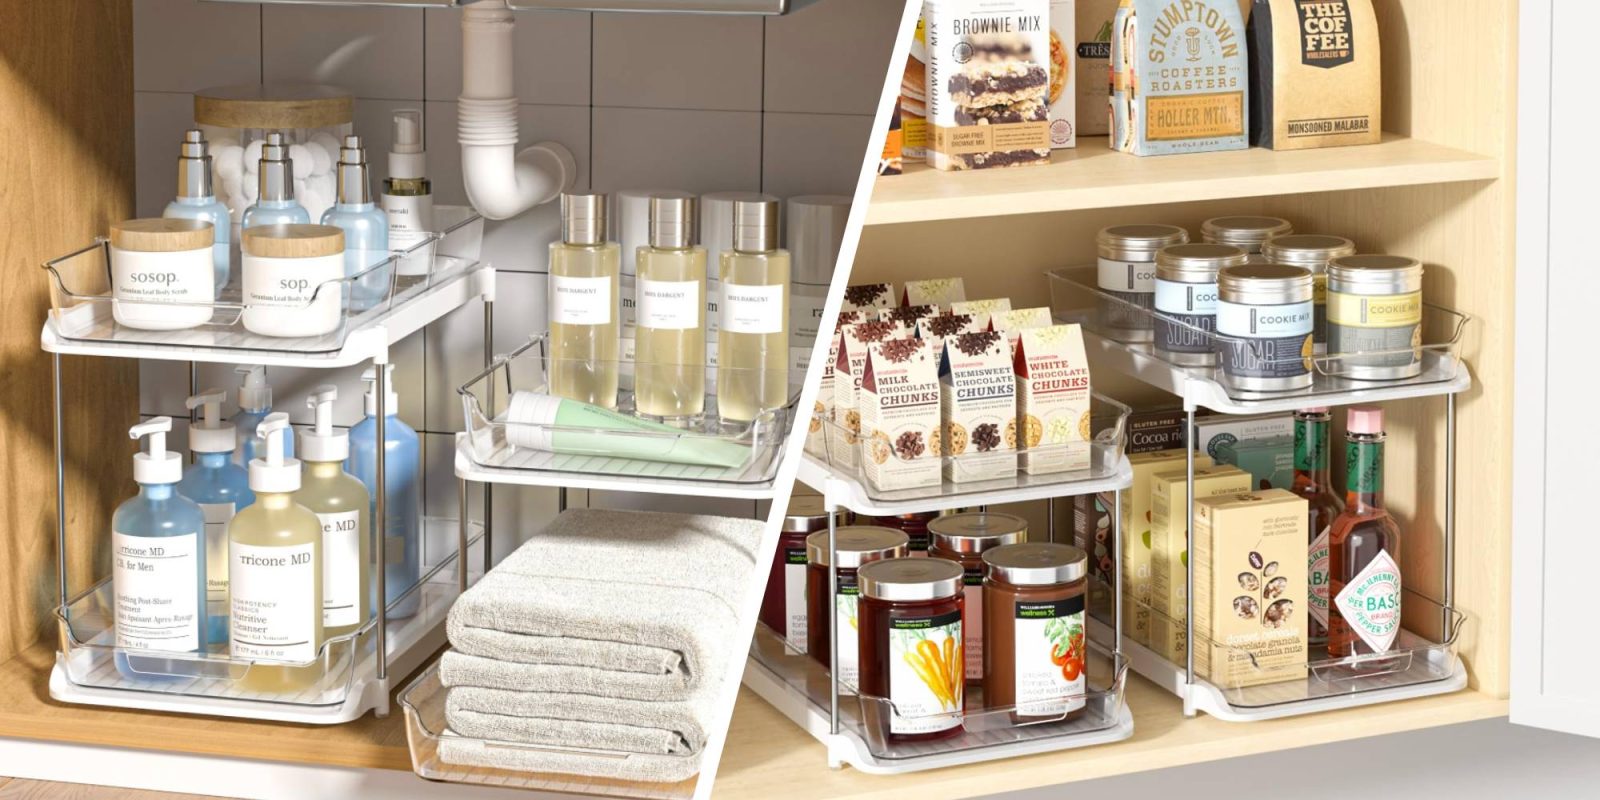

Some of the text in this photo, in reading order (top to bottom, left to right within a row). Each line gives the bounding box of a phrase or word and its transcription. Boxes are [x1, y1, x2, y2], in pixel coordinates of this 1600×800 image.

[1301, 3, 1346, 17] THE
[953, 16, 1041, 36] BROWNIE MIX
[1149, 0, 1239, 63] STUMPTOWN
[1304, 18, 1347, 33] COF
[1305, 34, 1349, 51] FEE
[1083, 43, 1110, 57] TRÊS
[1161, 66, 1227, 79] COFFEE
[1151, 77, 1237, 92] ROASTERS
[1157, 108, 1200, 128] HOLLER
[1288, 119, 1369, 135] MONSOONED MALABAR
[1370, 305, 1406, 316] COOKIE
[1260, 312, 1311, 326] COOKIE MIX
[1029, 359, 1069, 372] WHITE
[954, 366, 1012, 380] SEMISWEET
[1031, 367, 1088, 380] CHOCOLATE
[878, 375, 909, 386] MILK
[956, 375, 1014, 388] CHOCOLATE
[1032, 377, 1088, 391] CHUNKS
[879, 382, 938, 395] CHOCOLATE
[957, 384, 1014, 399] CHUNKS
[881, 391, 939, 406] CHUNKS
[1132, 430, 1169, 446] Cocoa
[336, 519, 356, 533] MD
[149, 546, 165, 557] MD
[290, 552, 312, 567] MD
[137, 561, 155, 573] Men
[1267, 637, 1301, 650] granola
[1283, 644, 1303, 655] nuts
